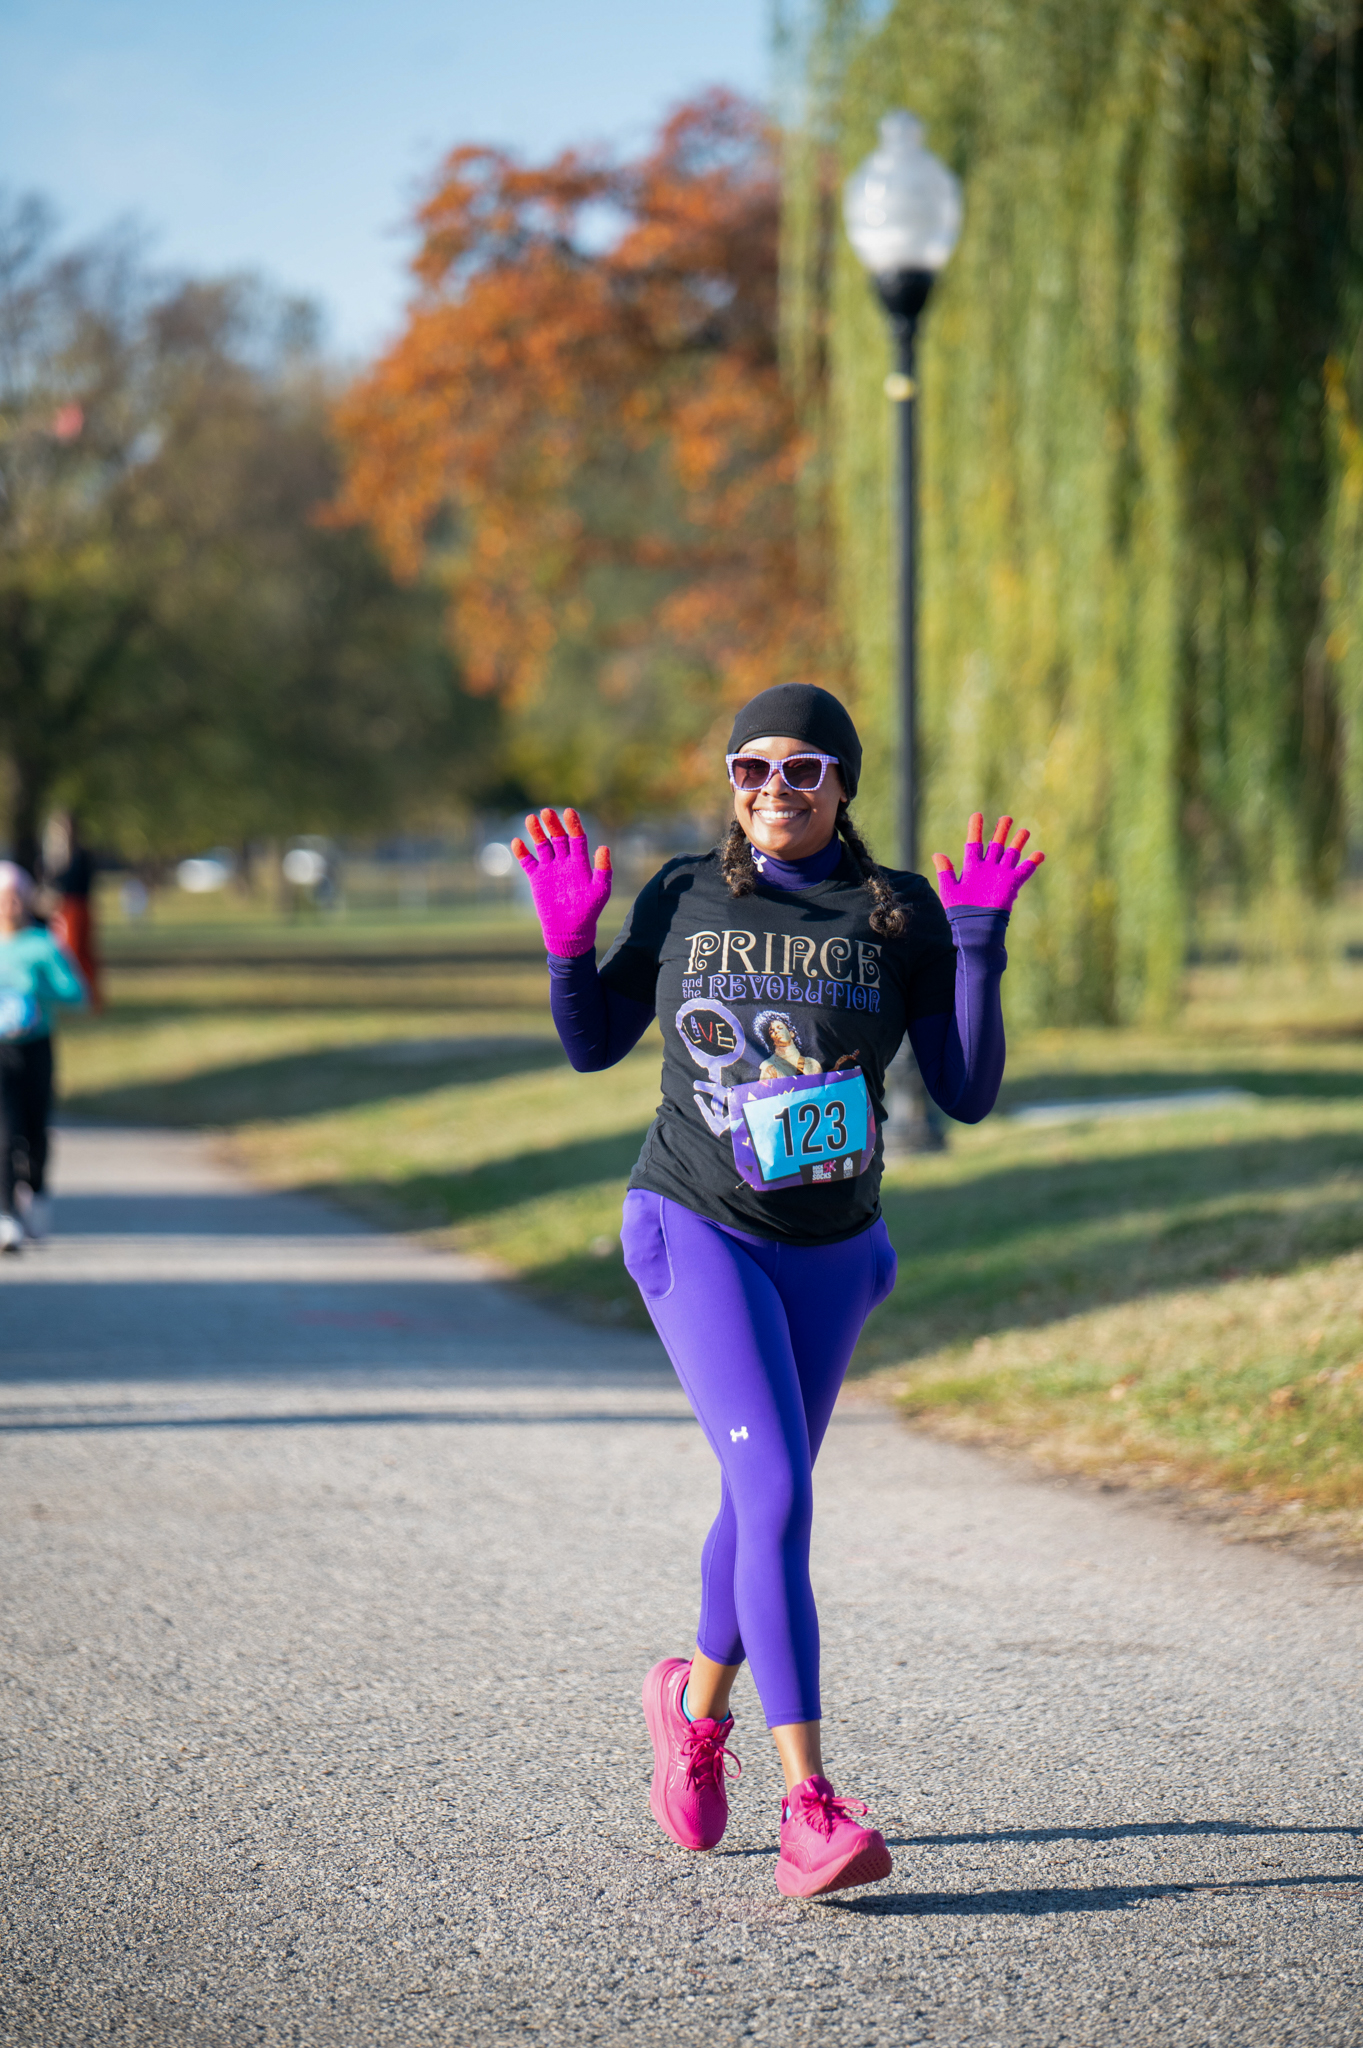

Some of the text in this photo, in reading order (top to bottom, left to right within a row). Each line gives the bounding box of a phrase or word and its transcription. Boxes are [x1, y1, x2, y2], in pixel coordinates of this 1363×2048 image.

[684, 930, 882, 988] PRINCE
[682, 975, 703, 988] and
[682, 987, 701, 999] the
[707, 973, 881, 1013] REVOLUTION
[773, 1100, 848, 1158] 123
[823, 1160, 836, 1173] 5K
[812, 1172, 831, 1180] SOCKS
